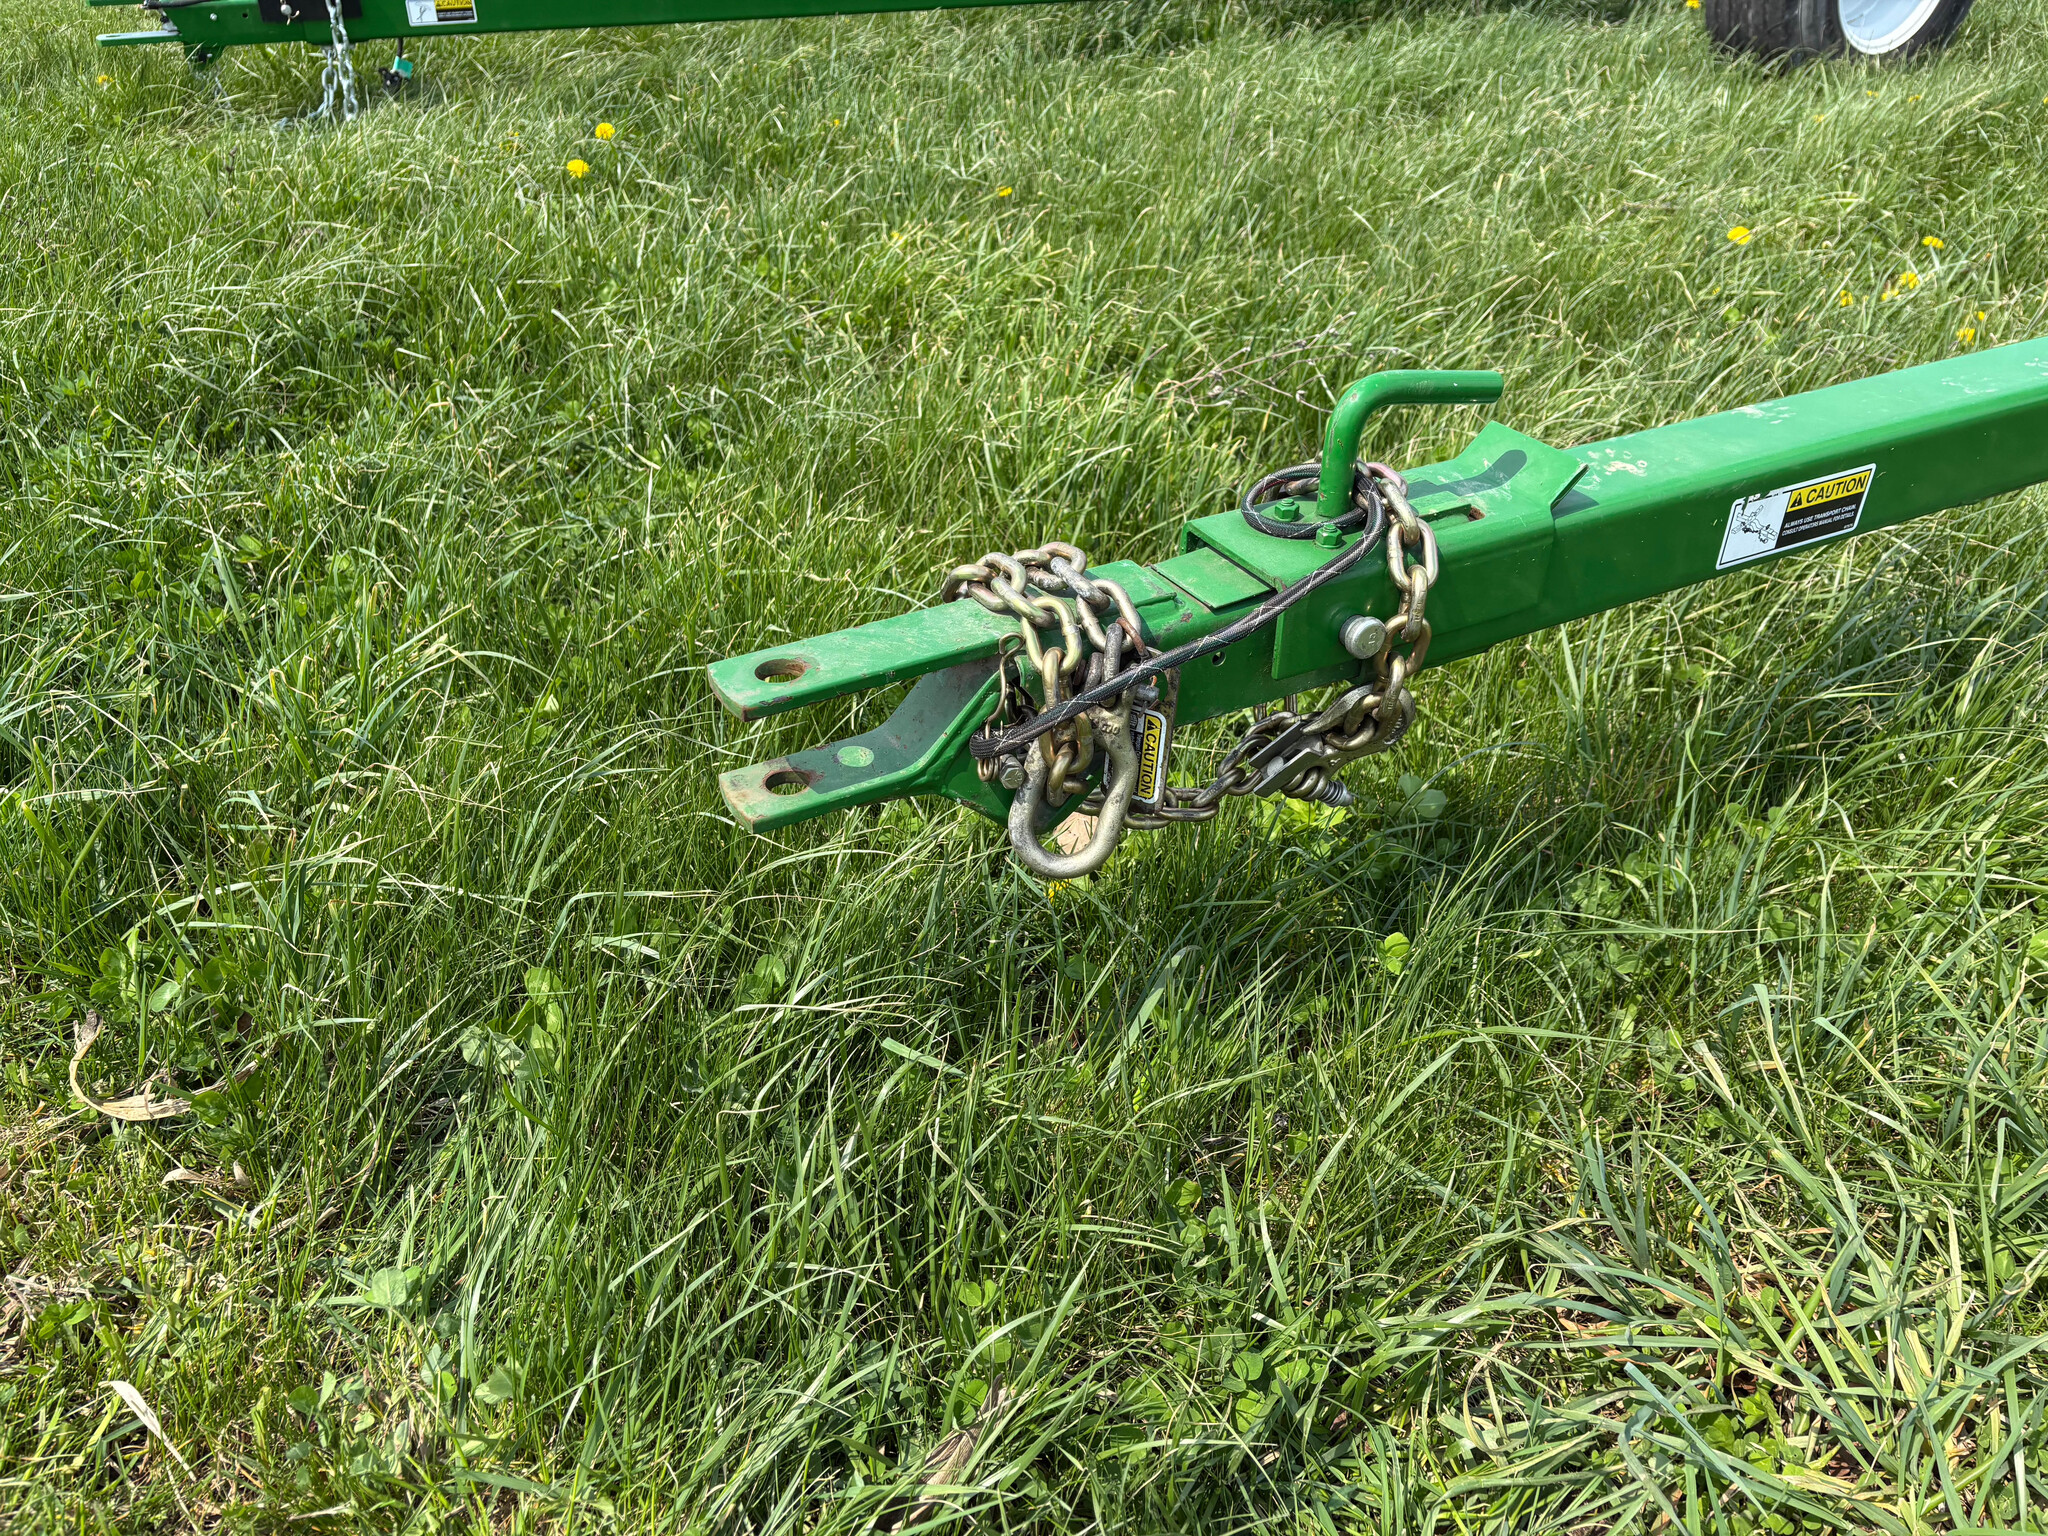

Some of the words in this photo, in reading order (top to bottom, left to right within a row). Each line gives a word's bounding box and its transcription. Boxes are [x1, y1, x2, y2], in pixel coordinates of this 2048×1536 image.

[1806, 475, 1867, 504] CAUTION
[1784, 518, 1804, 529] ALWAYS
[1803, 515, 1814, 523] USE
[1814, 508, 1841, 520] TRANSPORT
[1140, 733, 1157, 796] CAUTION
